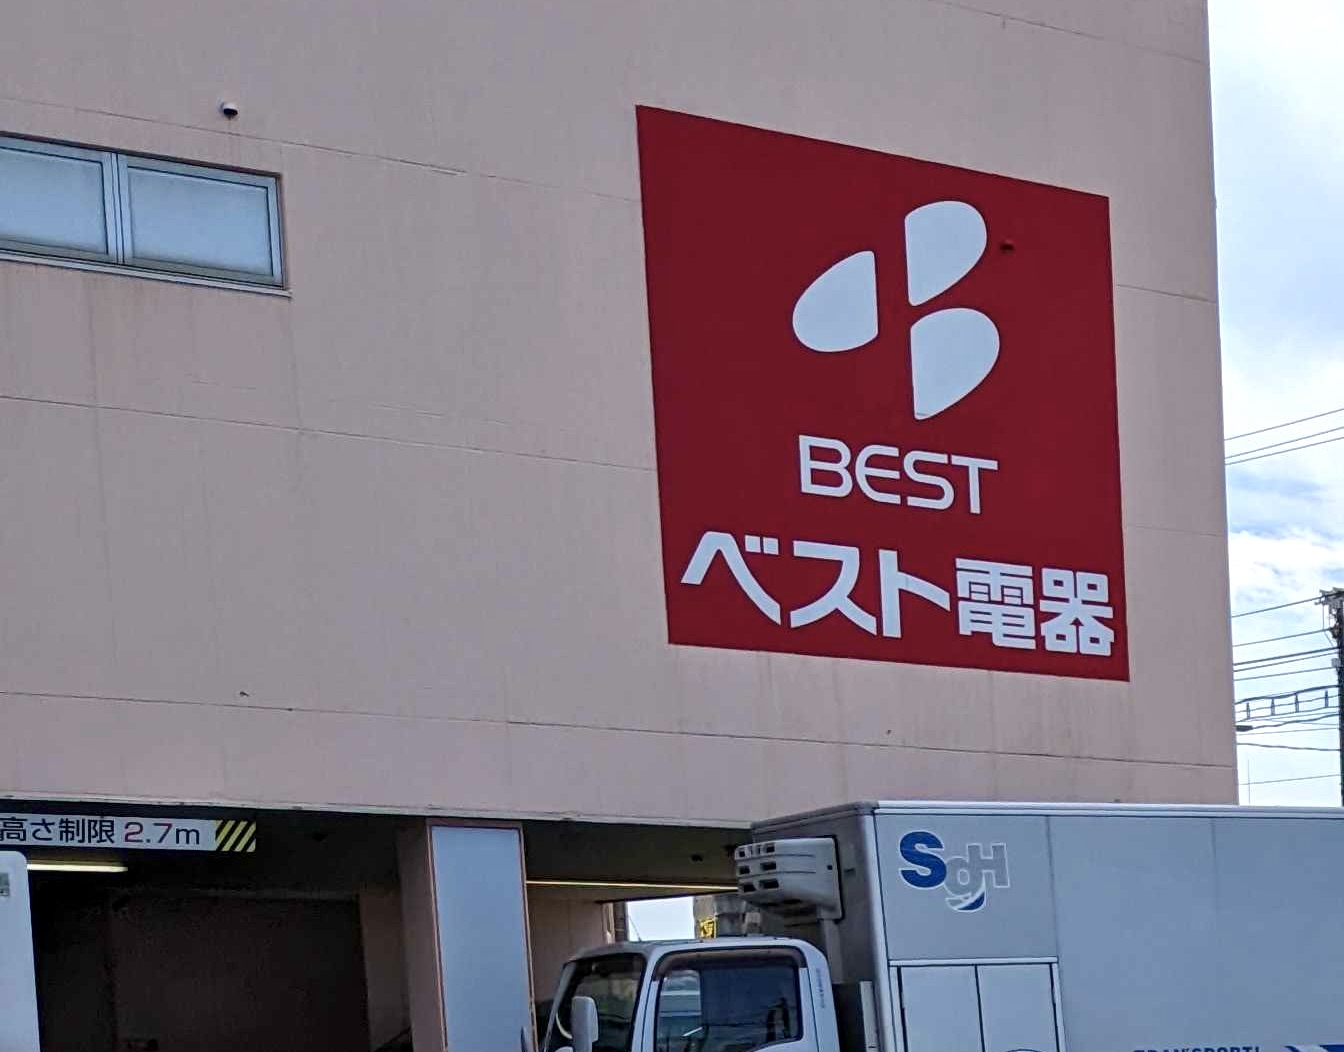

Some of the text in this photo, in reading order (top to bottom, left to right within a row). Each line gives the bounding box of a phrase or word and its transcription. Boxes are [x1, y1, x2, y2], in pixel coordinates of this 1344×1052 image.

[799, 435, 998, 514] BEST
[681, 531, 1115, 657] ベスト電器
[0, 817, 200, 845] 高さ制限 2.7m
